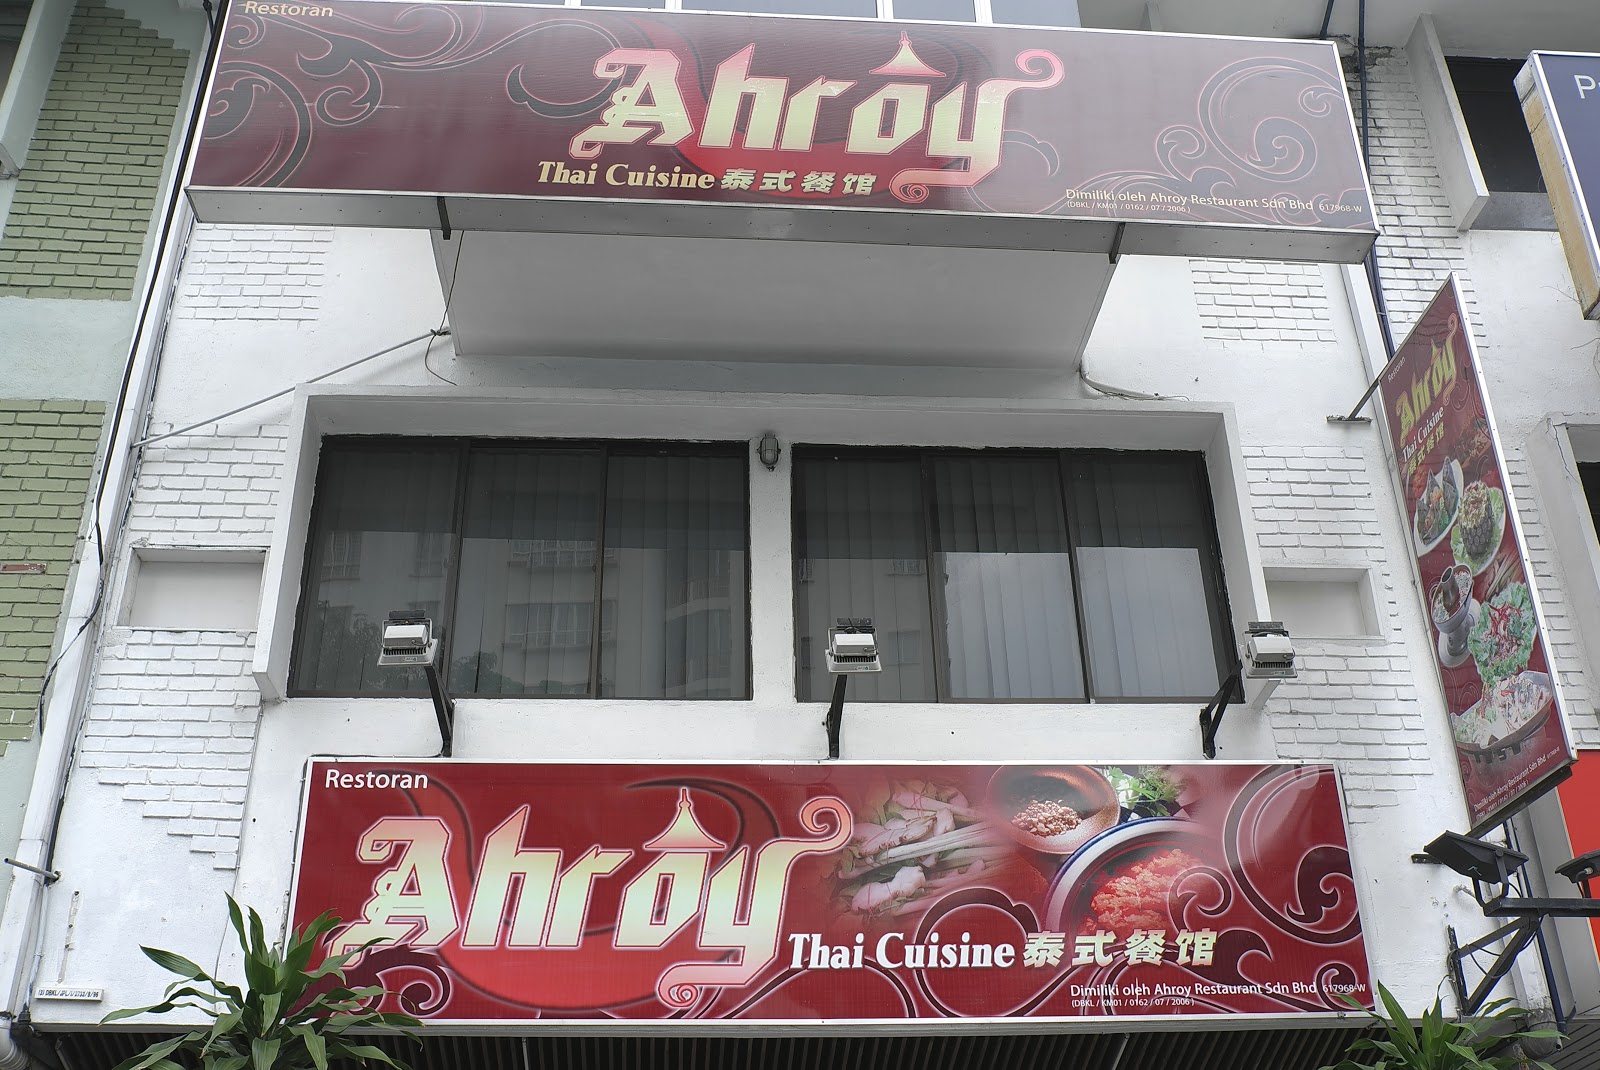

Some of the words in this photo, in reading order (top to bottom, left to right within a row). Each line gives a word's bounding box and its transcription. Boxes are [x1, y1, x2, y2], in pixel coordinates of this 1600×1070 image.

[244, 1, 334, 17] Restoran
[1574, 74, 1600, 98] P
[568, 31, 1066, 203] Ahroy
[537, 161, 598, 185] Thai
[605, 163, 715, 189] Cuisine
[720, 168, 877, 196] 泰式餐馆
[1066, 189, 1115, 202] Dimiliki
[1118, 191, 1146, 202] oleh
[1150, 192, 1188, 206] Ahroy
[1191, 194, 1259, 208] Restaurant
[1261, 198, 1286, 209] Sdn
[1289, 199, 1313, 210] Bhd
[1319, 202, 1362, 213] 617968-W
[1067, 201, 1091, 209] (DBKL
[1125, 203, 1144, 211] 0162
[1396, 313, 1458, 449] Ahroy
[1402, 436, 1418, 464] Thai
[1417, 405, 1445, 443] Cuisine
[325, 768, 428, 789] Restoran
[324, 787, 852, 1008] Ahroy
[788, 932, 864, 969] Thai
[876, 931, 1015, 969] Cuisine
[1023, 929, 1218, 969] 泰式餐馆
[1070, 984, 1119, 997] Dimiliki
[1122, 984, 1151, 996] oleh
[1154, 983, 1191, 998] Ahroy
[1195, 982, 1263, 995] Restaurant
[1265, 982, 1289, 994] Sdn
[1292, 981, 1317, 993] Bhd
[1322, 984, 1366, 993] 617968-W
[1071, 998, 1094, 1008] (DBKL
[1129, 998, 1148, 1006] 0162
[1155, 998, 1164, 1006] 07
